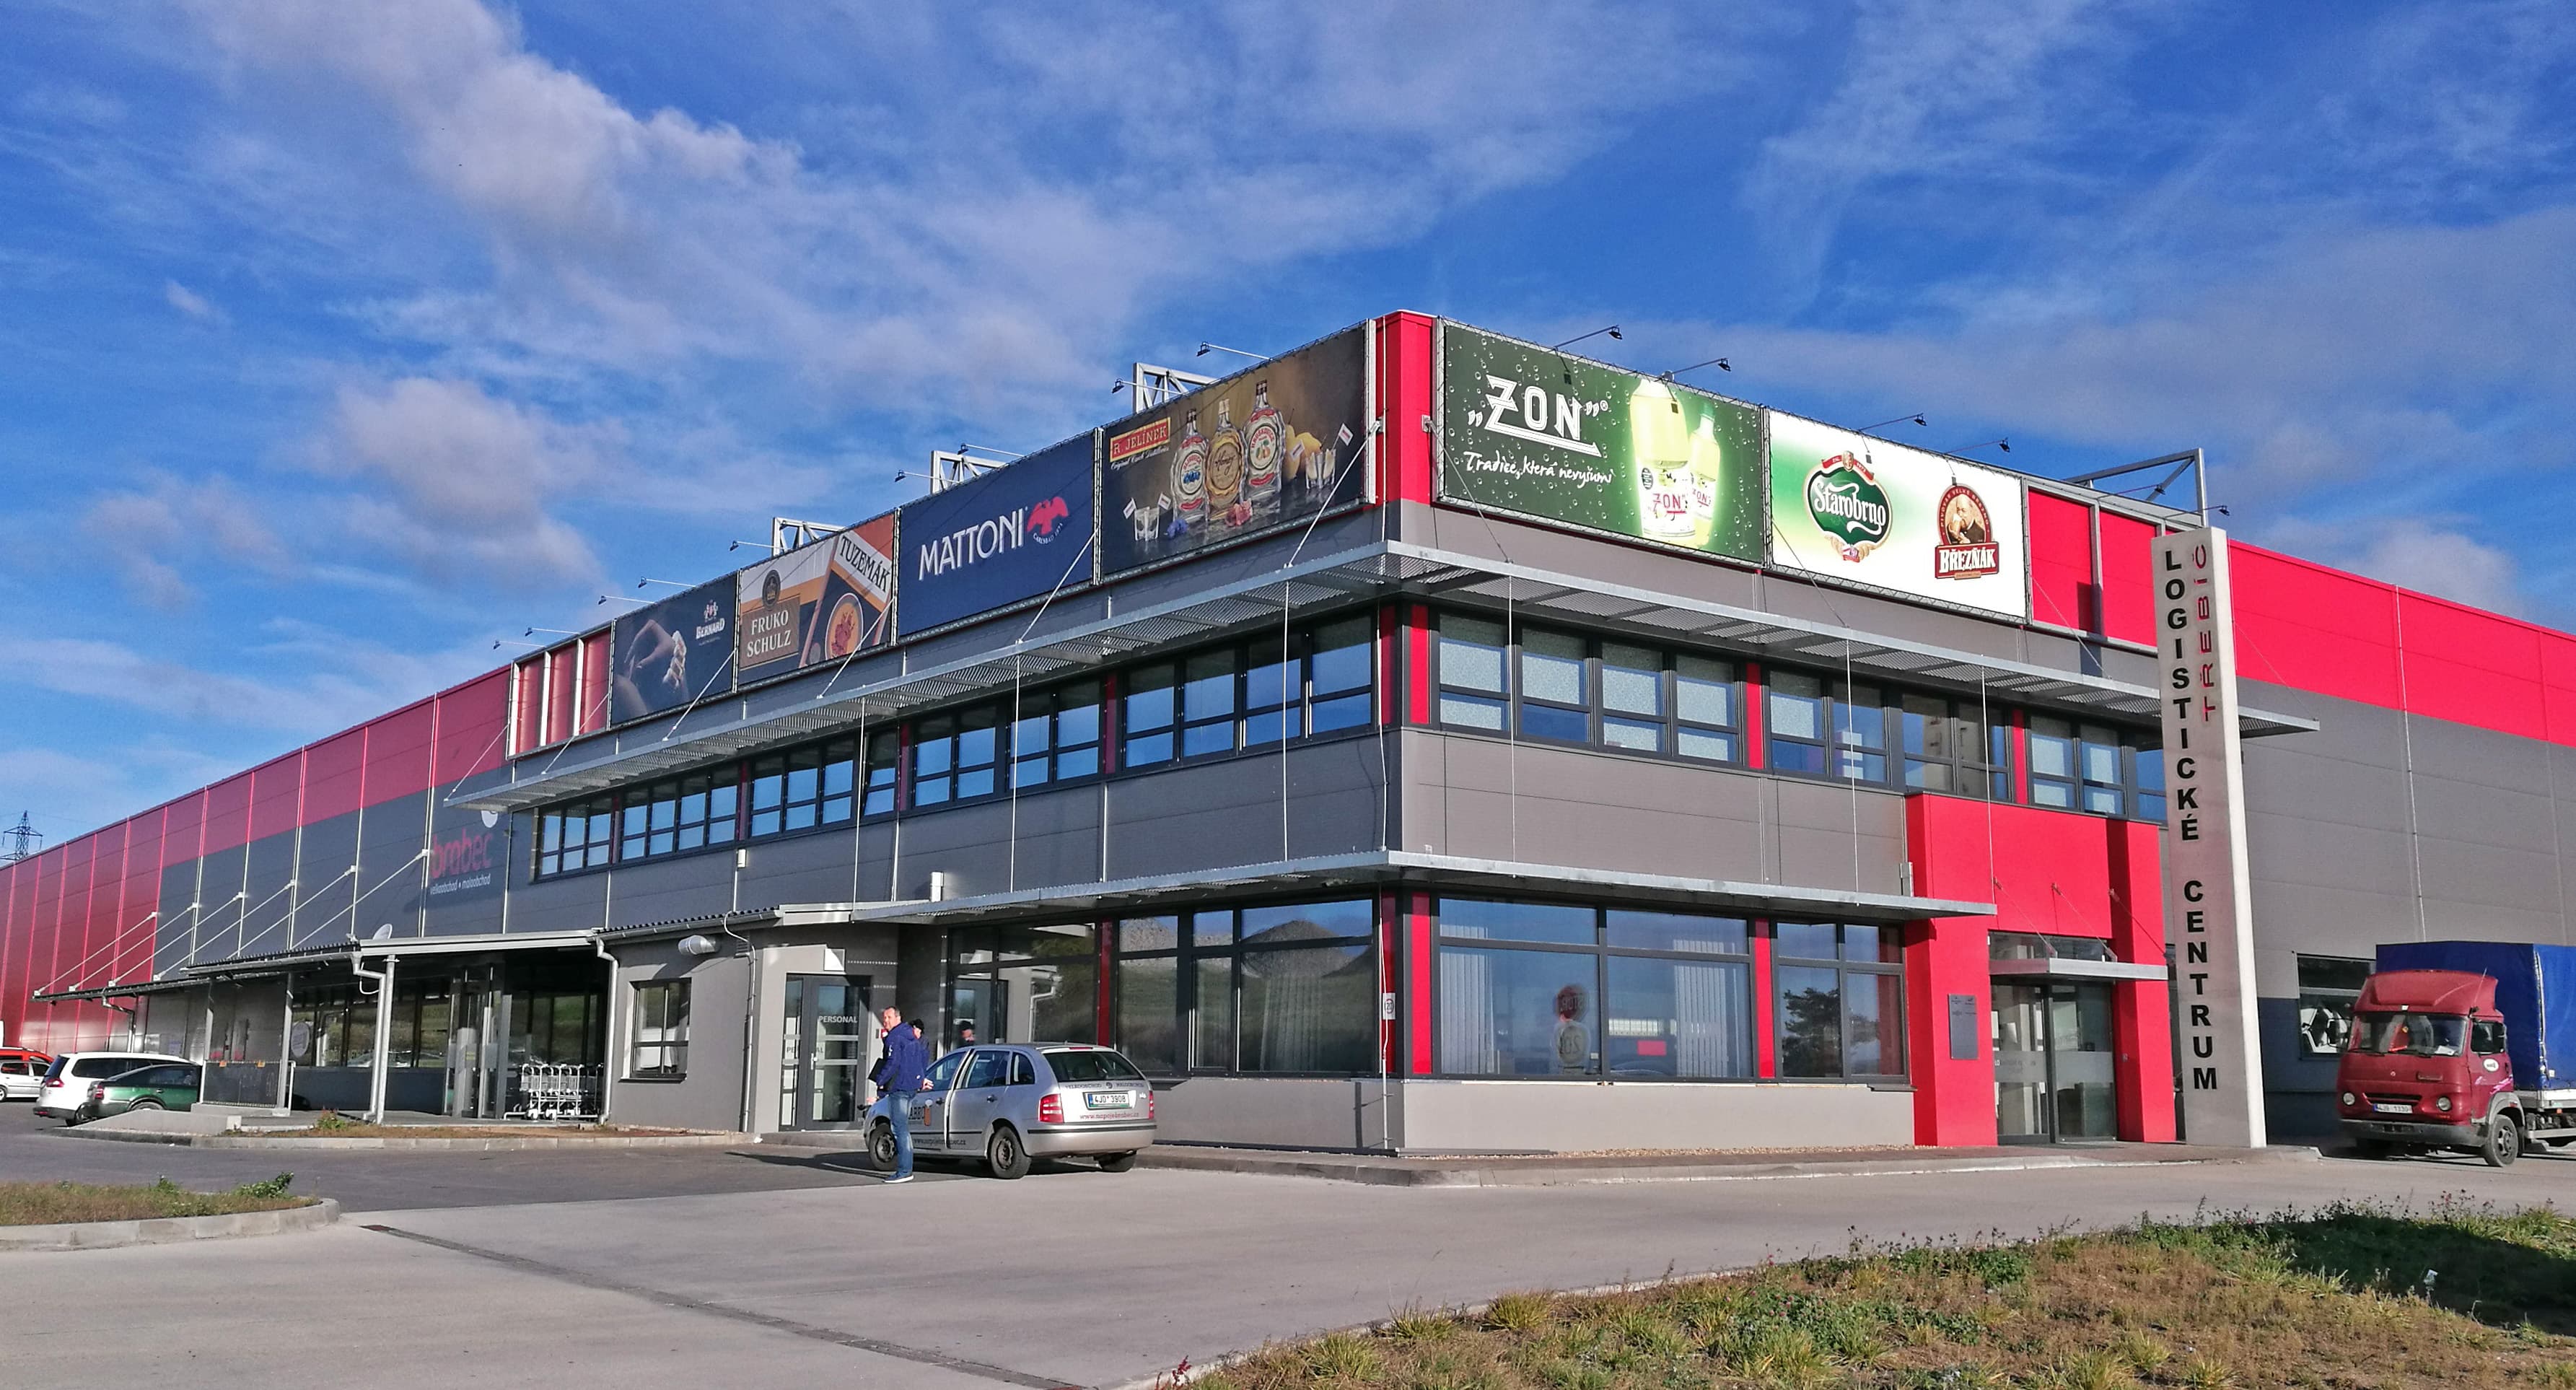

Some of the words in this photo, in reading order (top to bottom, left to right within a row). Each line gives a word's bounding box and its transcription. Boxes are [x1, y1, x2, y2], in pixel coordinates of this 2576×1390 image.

[1126, 426, 1167, 450] JELÍNEK
[1522, 456, 1559, 477] která
[1559, 465, 1616, 489] nevyšumí
[1814, 479, 1886, 535] Starobrno
[919, 508, 1025, 581] MATTONI
[1939, 547, 1997, 573] BŘEZŇÁK
[841, 535, 890, 593] TUZEMÁK
[696, 617, 725, 640] BERNARD
[751, 610, 789, 635] FRUKO
[747, 629, 792, 658] SCHULZ
[2165, 550, 2199, 842] LOGISTICKÉ
[2184, 880, 2217, 1090] CENTRUM
